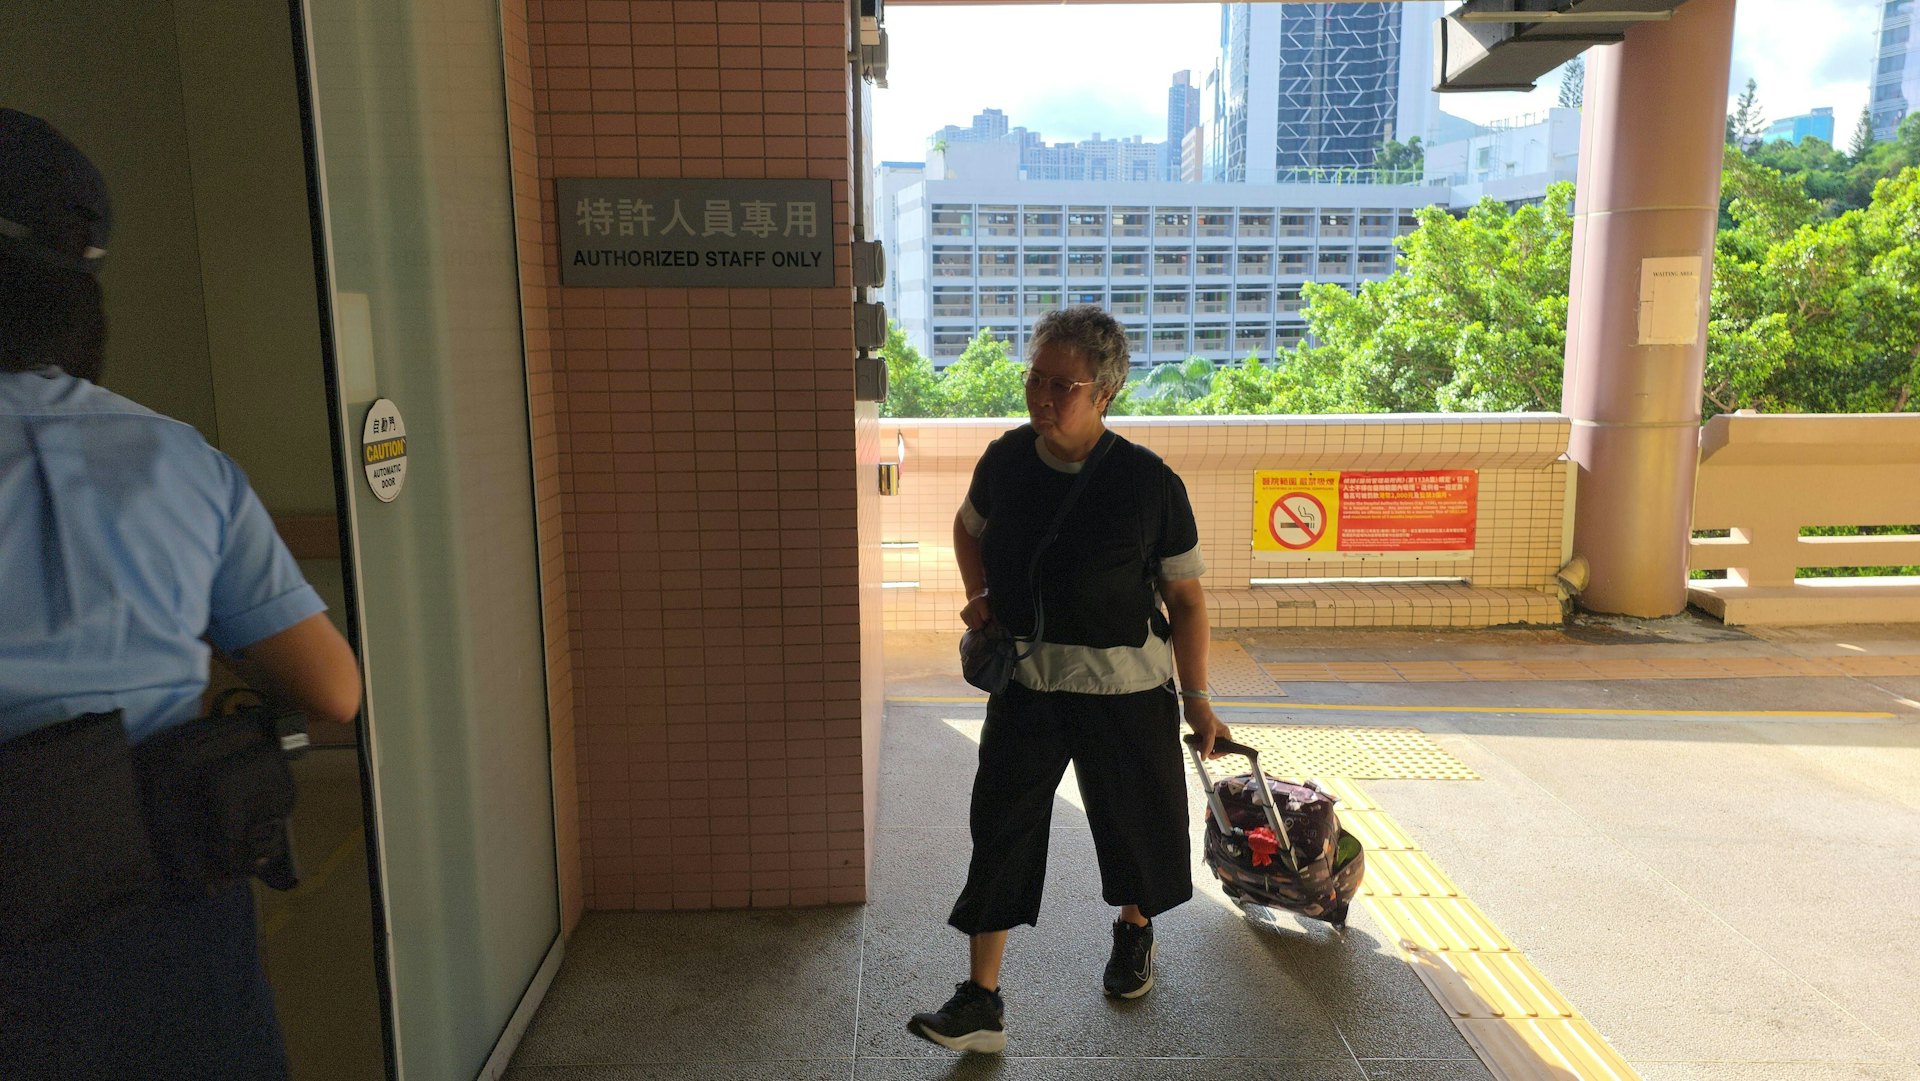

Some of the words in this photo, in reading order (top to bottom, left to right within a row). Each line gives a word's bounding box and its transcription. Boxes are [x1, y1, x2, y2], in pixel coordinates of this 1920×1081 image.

[576, 198, 817, 239] 特許人員專用
[573, 249, 700, 267] AUTHORIZED
[705, 251, 766, 267] STAFF
[771, 251, 822, 267] ONLY
[373, 416, 396, 434] 自動門
[366, 440, 404, 462] CAUTION
[373, 464, 401, 478] AUTOMATIC
[381, 478, 396, 488] DOOR
